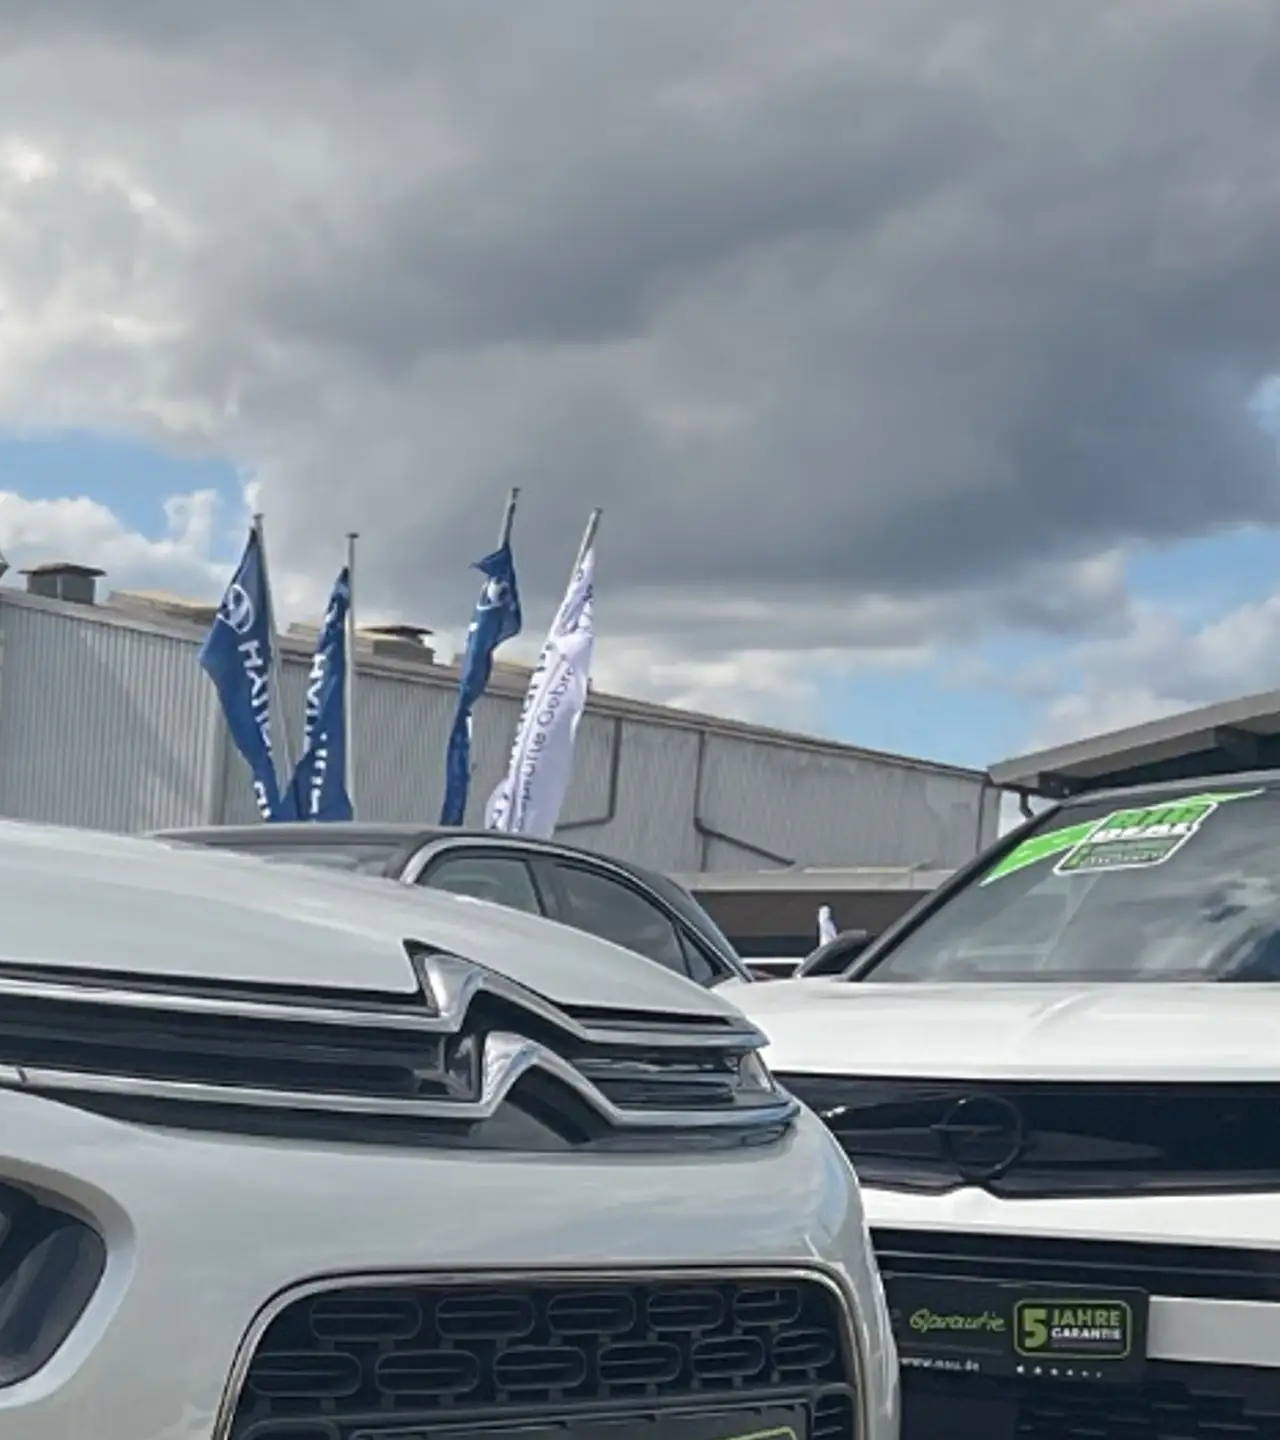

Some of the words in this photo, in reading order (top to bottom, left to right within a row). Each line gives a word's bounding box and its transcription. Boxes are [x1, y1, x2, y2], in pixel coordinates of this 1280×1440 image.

[909, 1308, 1006, 1333] Garantie
[1023, 1308, 1049, 1348] 5
[1051, 1308, 1122, 1327] JAHRE
[1051, 1326, 1123, 1341] GARANTIE
